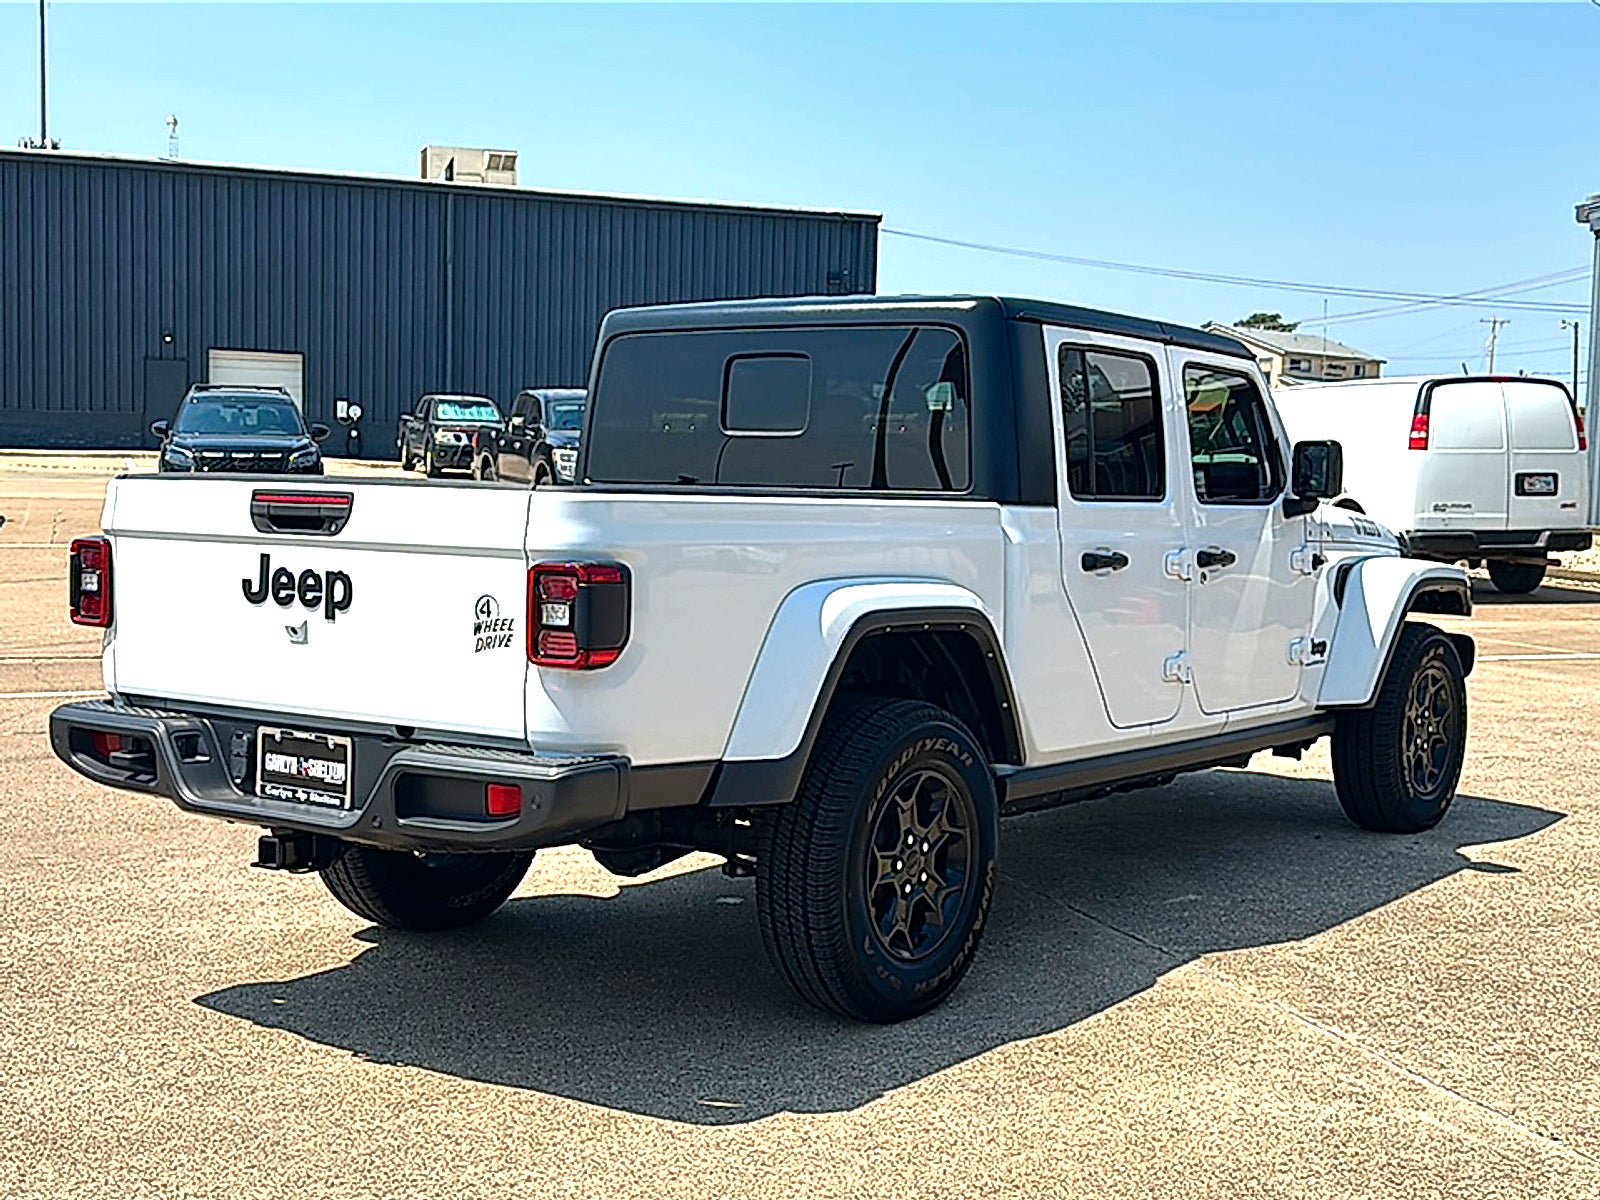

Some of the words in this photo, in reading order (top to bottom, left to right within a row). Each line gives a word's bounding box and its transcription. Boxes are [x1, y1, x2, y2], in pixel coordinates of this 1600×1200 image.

[242, 553, 353, 620] Jeep
[479, 598, 492, 618] 4
[473, 618, 515, 636] WHEEL
[474, 633, 514, 653] DRIVE
[866, 737, 974, 824] GOODYEAR
